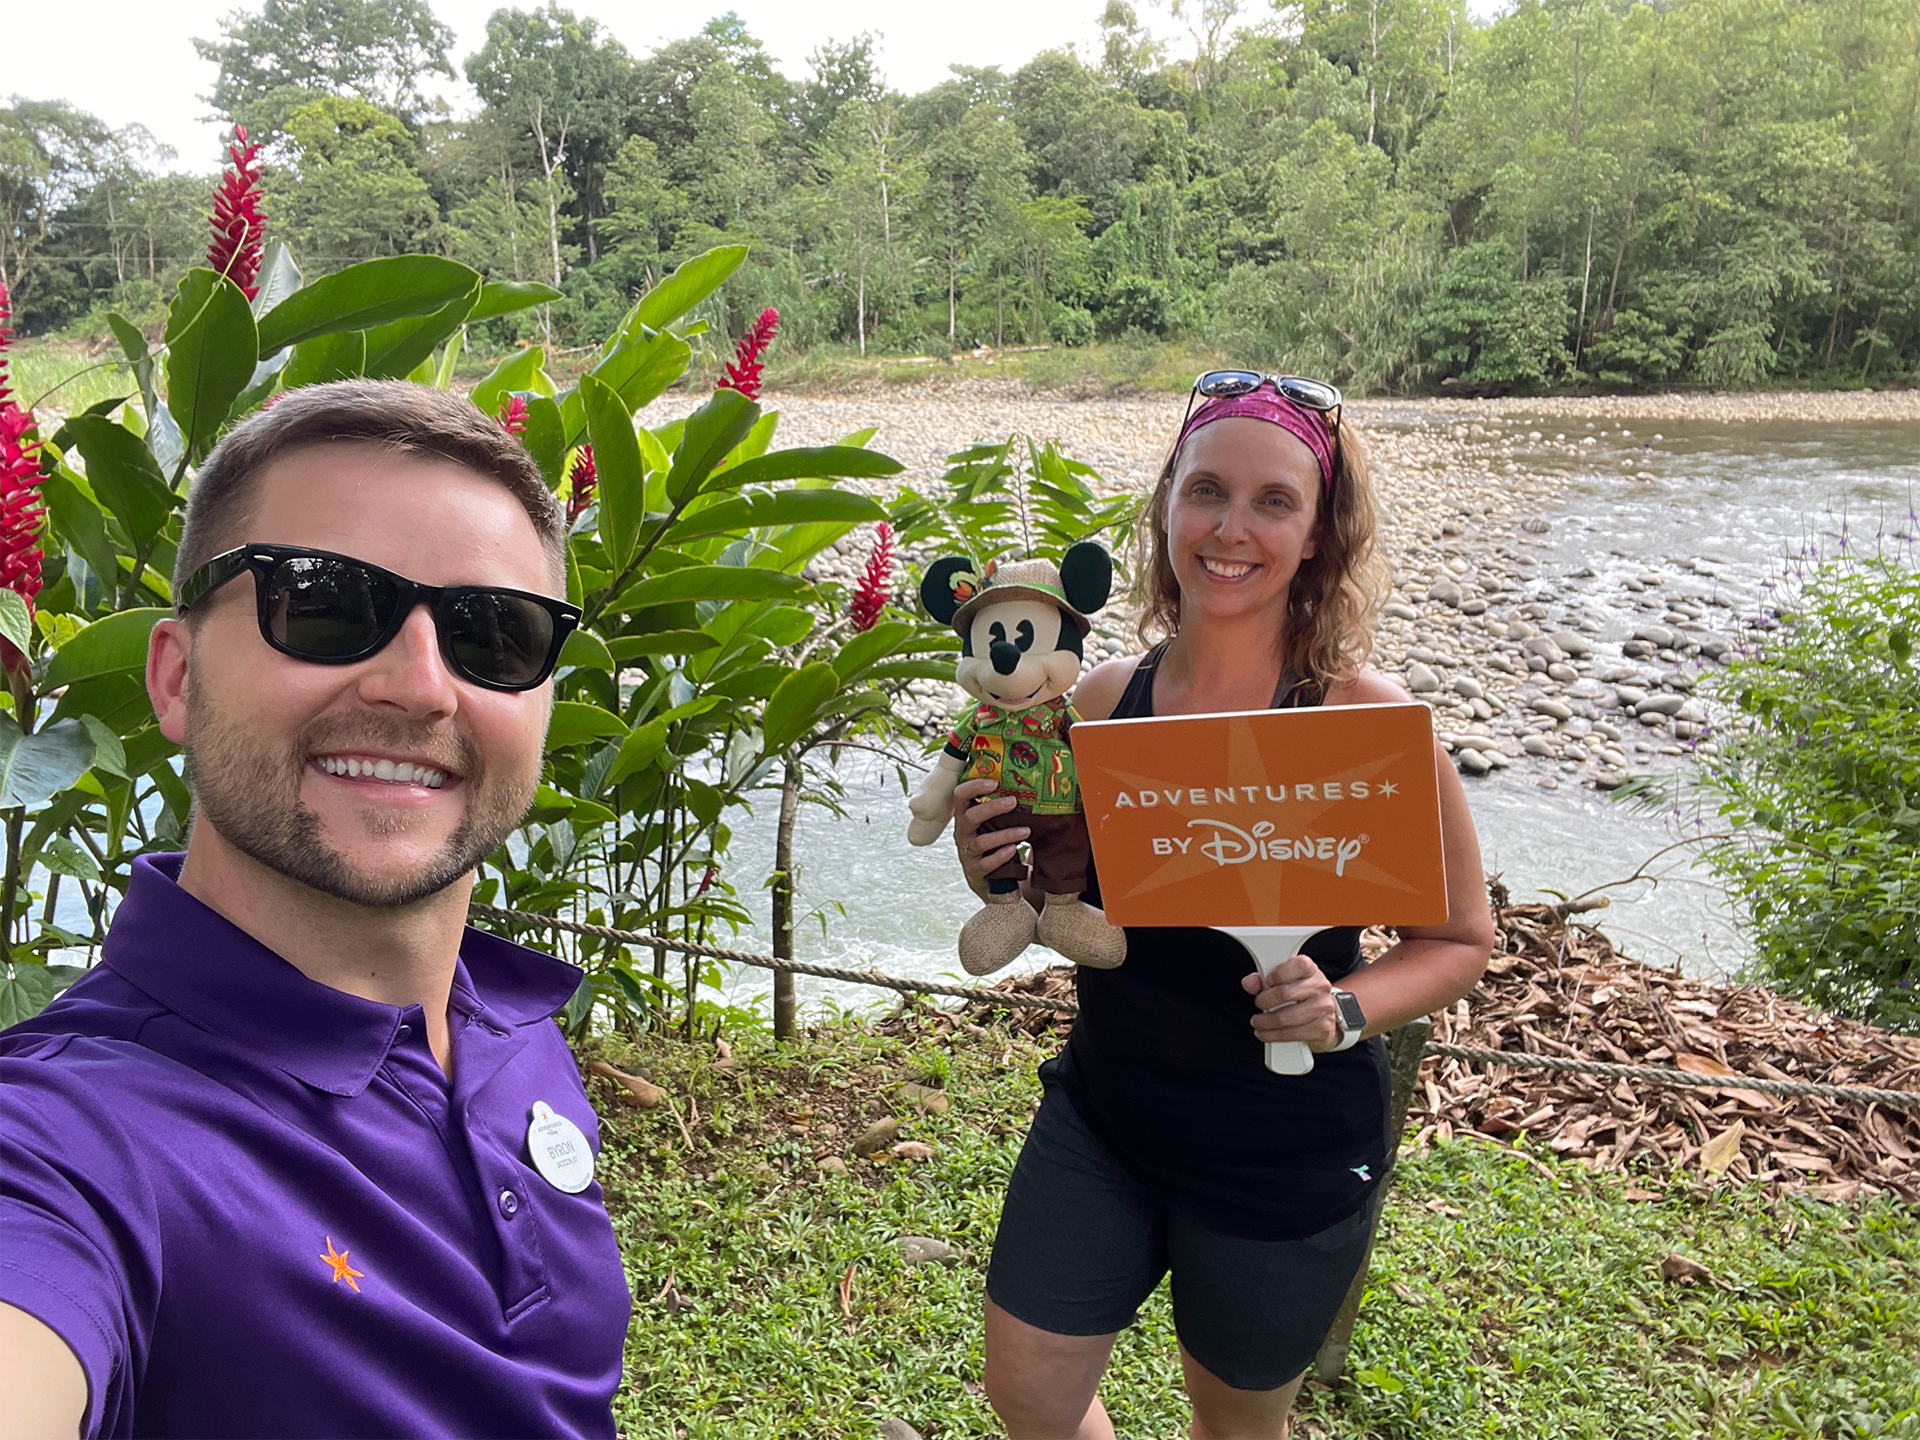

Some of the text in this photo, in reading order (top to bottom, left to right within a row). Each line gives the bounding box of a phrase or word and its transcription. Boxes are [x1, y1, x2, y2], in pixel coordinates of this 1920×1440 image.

[1115, 781, 1370, 808] ADVENTURES
[1152, 837, 1193, 855] BY
[547, 1140, 576, 1159] BYRON
